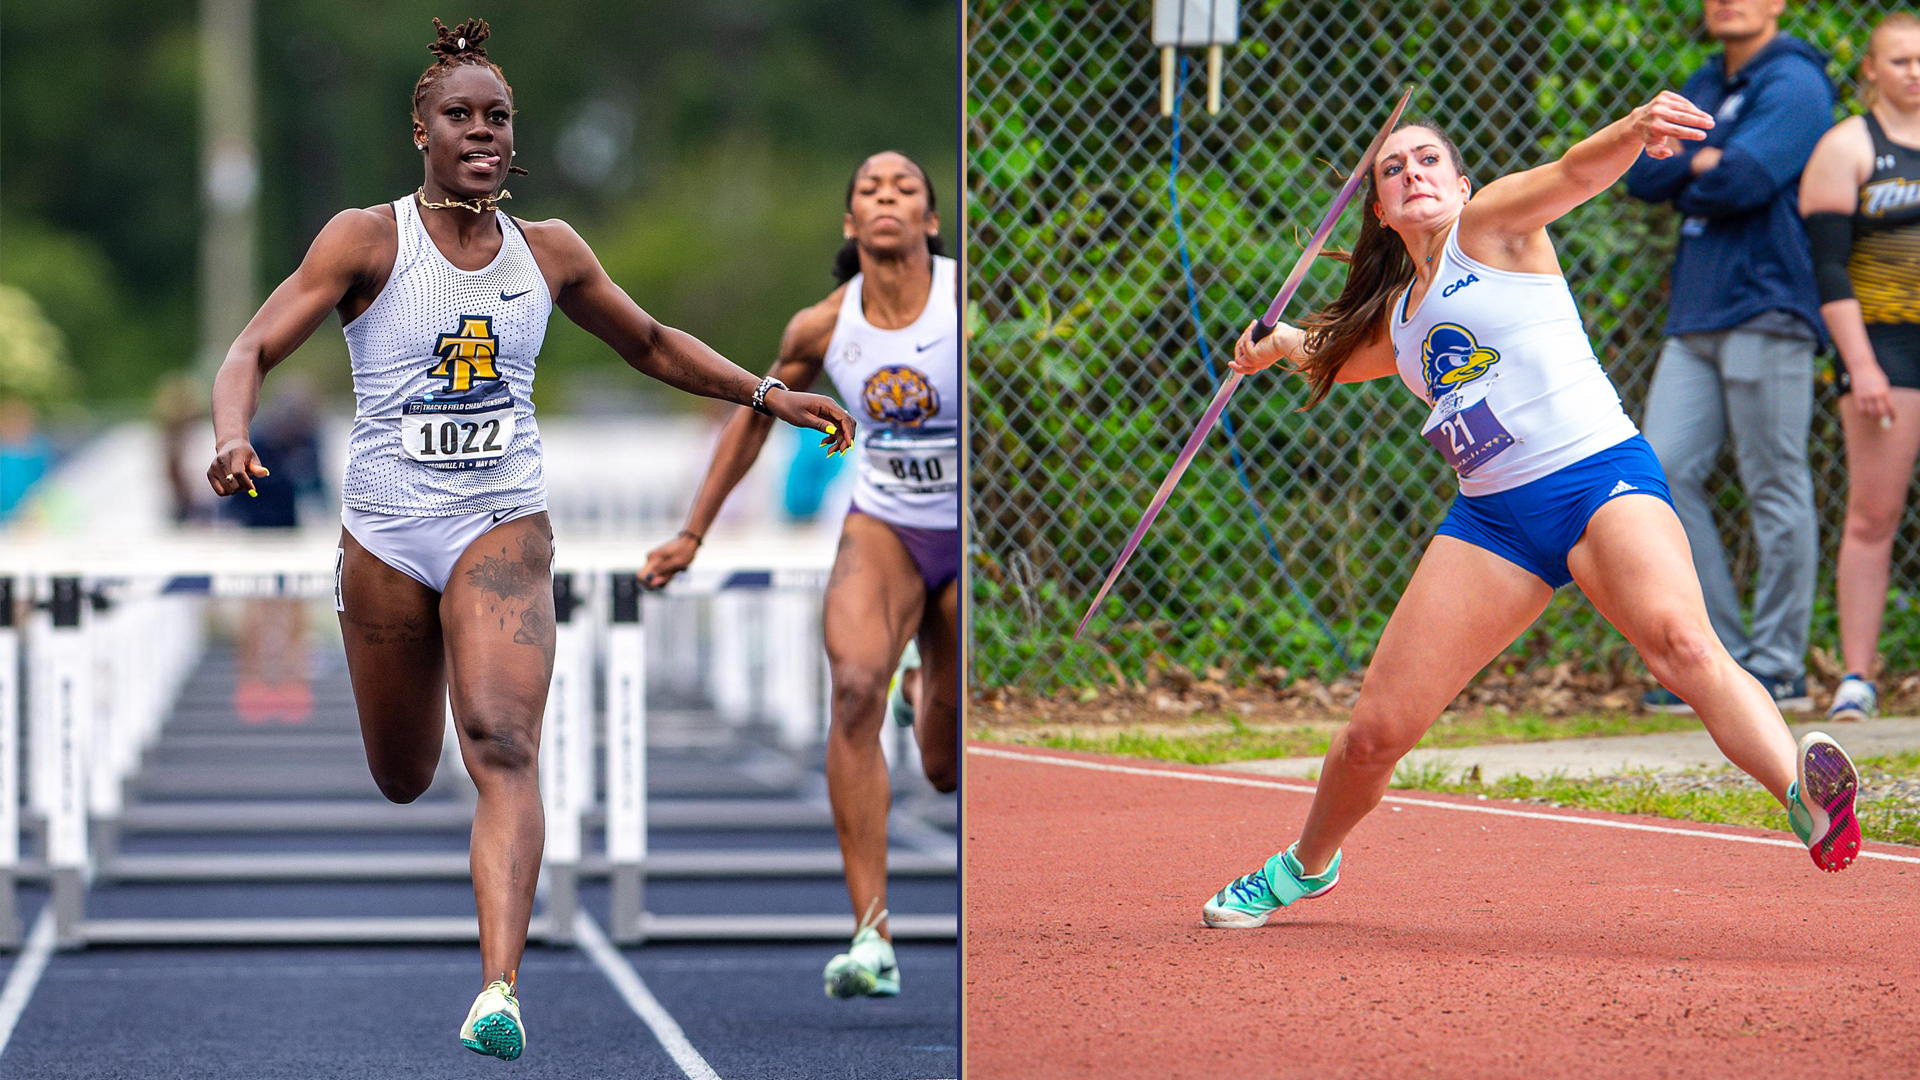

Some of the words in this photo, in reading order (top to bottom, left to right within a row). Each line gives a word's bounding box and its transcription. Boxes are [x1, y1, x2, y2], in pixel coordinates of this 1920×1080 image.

[1442, 273, 1480, 298] CAA
[422, 403, 442, 411] TRACK
[448, 402, 464, 411] FIELD
[465, 396, 511, 410] CHAMPIONSHIPS
[420, 419, 502, 456] 1022
[1440, 412, 1476, 455] 21
[475, 460, 488, 468] MAY
[889, 457, 942, 482] 840
